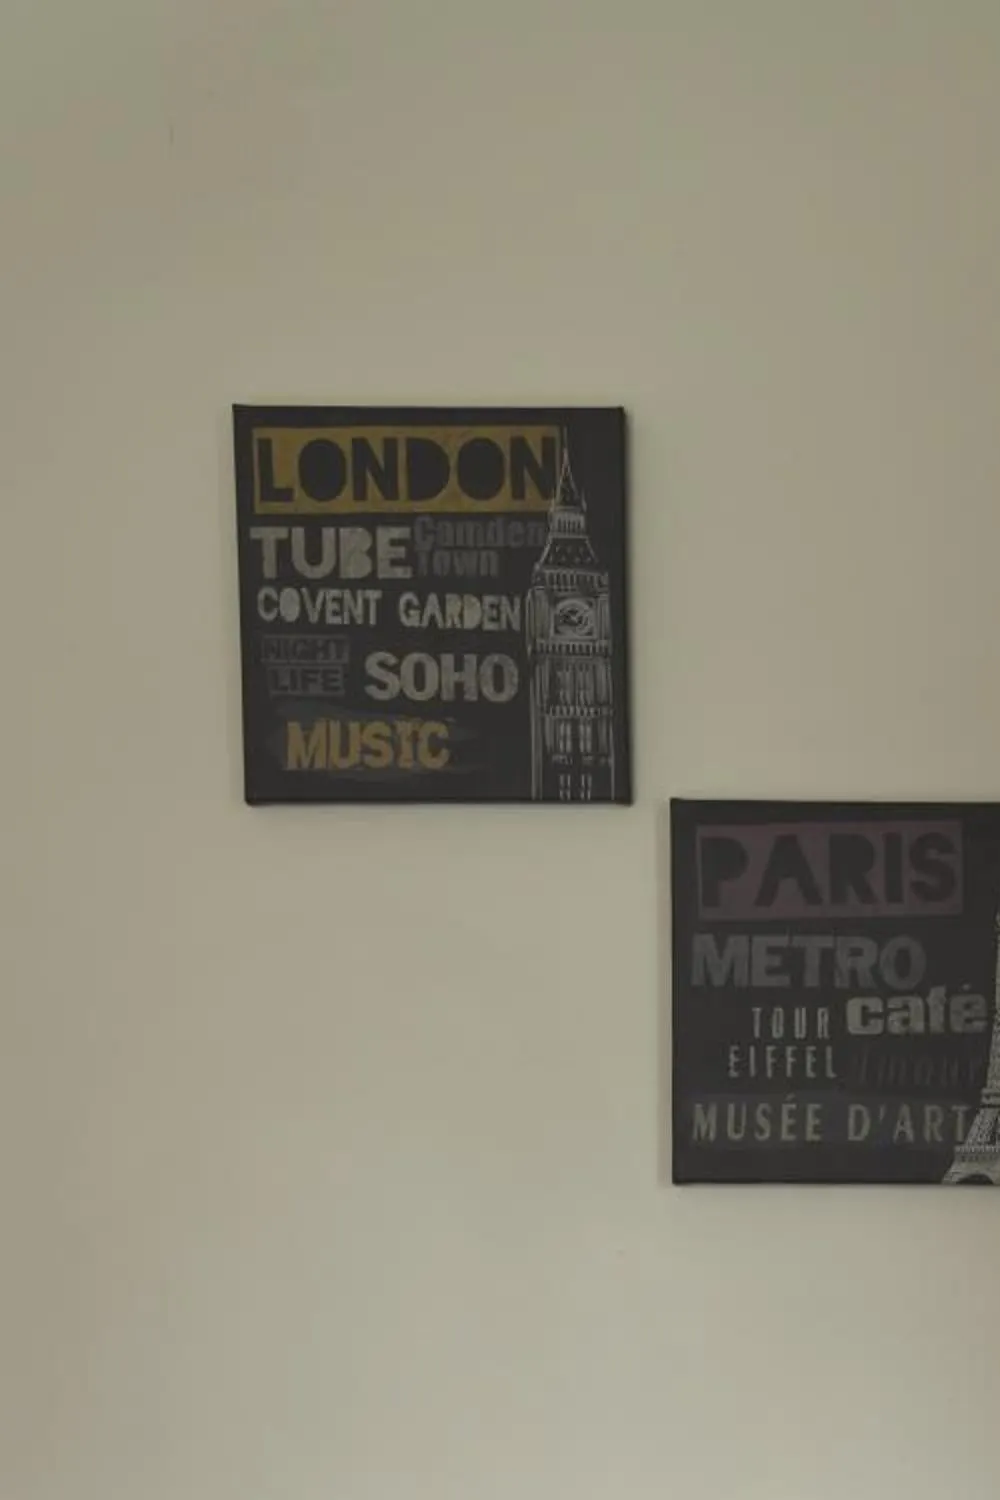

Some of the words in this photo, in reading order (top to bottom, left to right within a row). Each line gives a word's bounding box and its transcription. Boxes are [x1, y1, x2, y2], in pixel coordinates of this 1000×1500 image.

[256, 437, 554, 503] LONDON
[249, 526, 413, 580] TUBE
[414, 515, 545, 549] Camden
[416, 549, 499, 577] Town
[256, 587, 383, 625] COVENT
[398, 592, 521, 632] GARDEN
[264, 638, 348, 659] NIGHT
[273, 667, 341, 691] LIFE
[364, 651, 519, 703] SOHO
[285, 719, 452, 771] MUSIC
[699, 832, 958, 908] PARIS
[691, 933, 927, 988] METRO
[751, 1006, 831, 1039] TOUR
[846, 984, 989, 1035] café
[728, 1045, 837, 1079] EIFFEL
[693, 1093, 823, 1143] MUSÉE
[847, 1104, 971, 1143] D'ART
